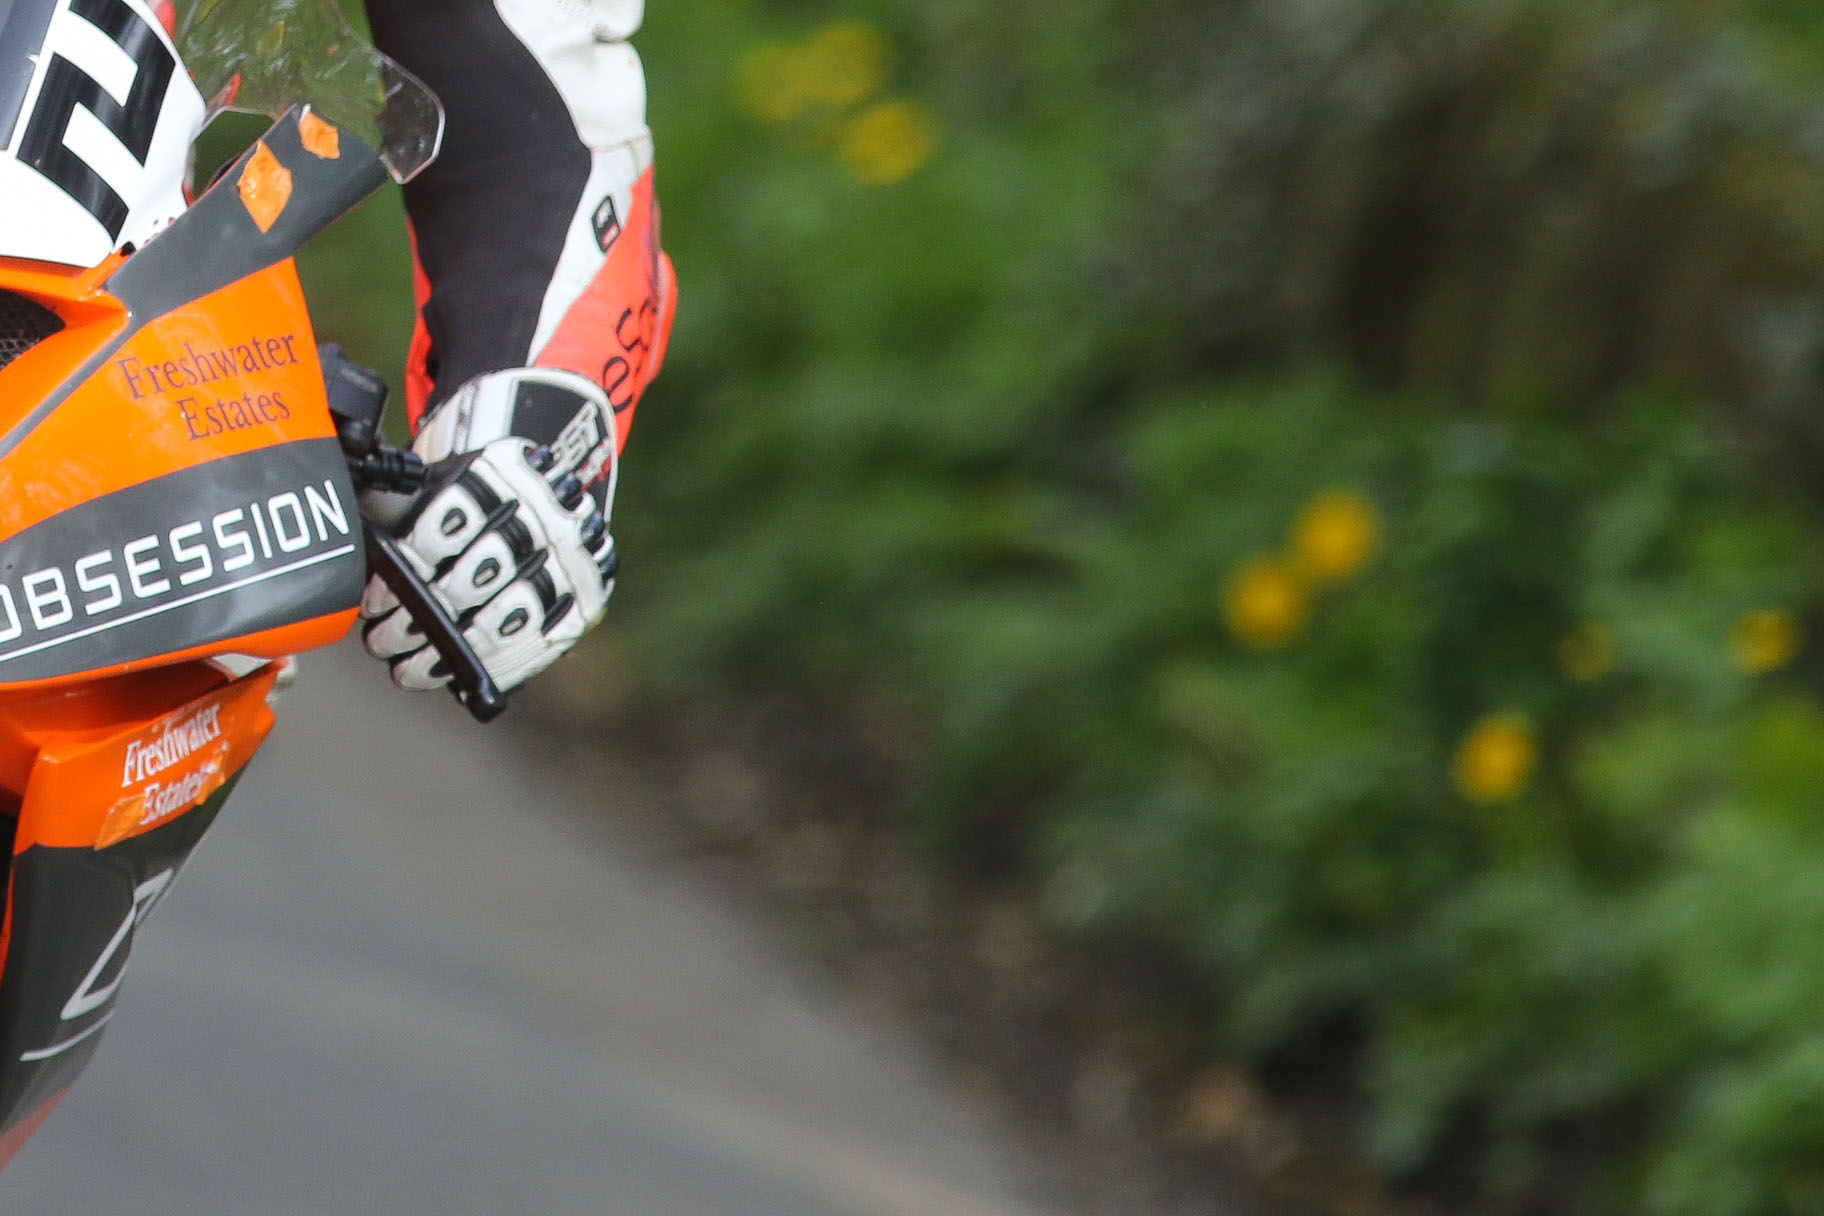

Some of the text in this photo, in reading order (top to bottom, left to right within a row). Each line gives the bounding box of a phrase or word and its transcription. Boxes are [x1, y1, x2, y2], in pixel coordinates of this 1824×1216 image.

[118, 329, 300, 401] Freshwater
[177, 391, 292, 444] Estates
[120, 702, 223, 789] Freshwater
